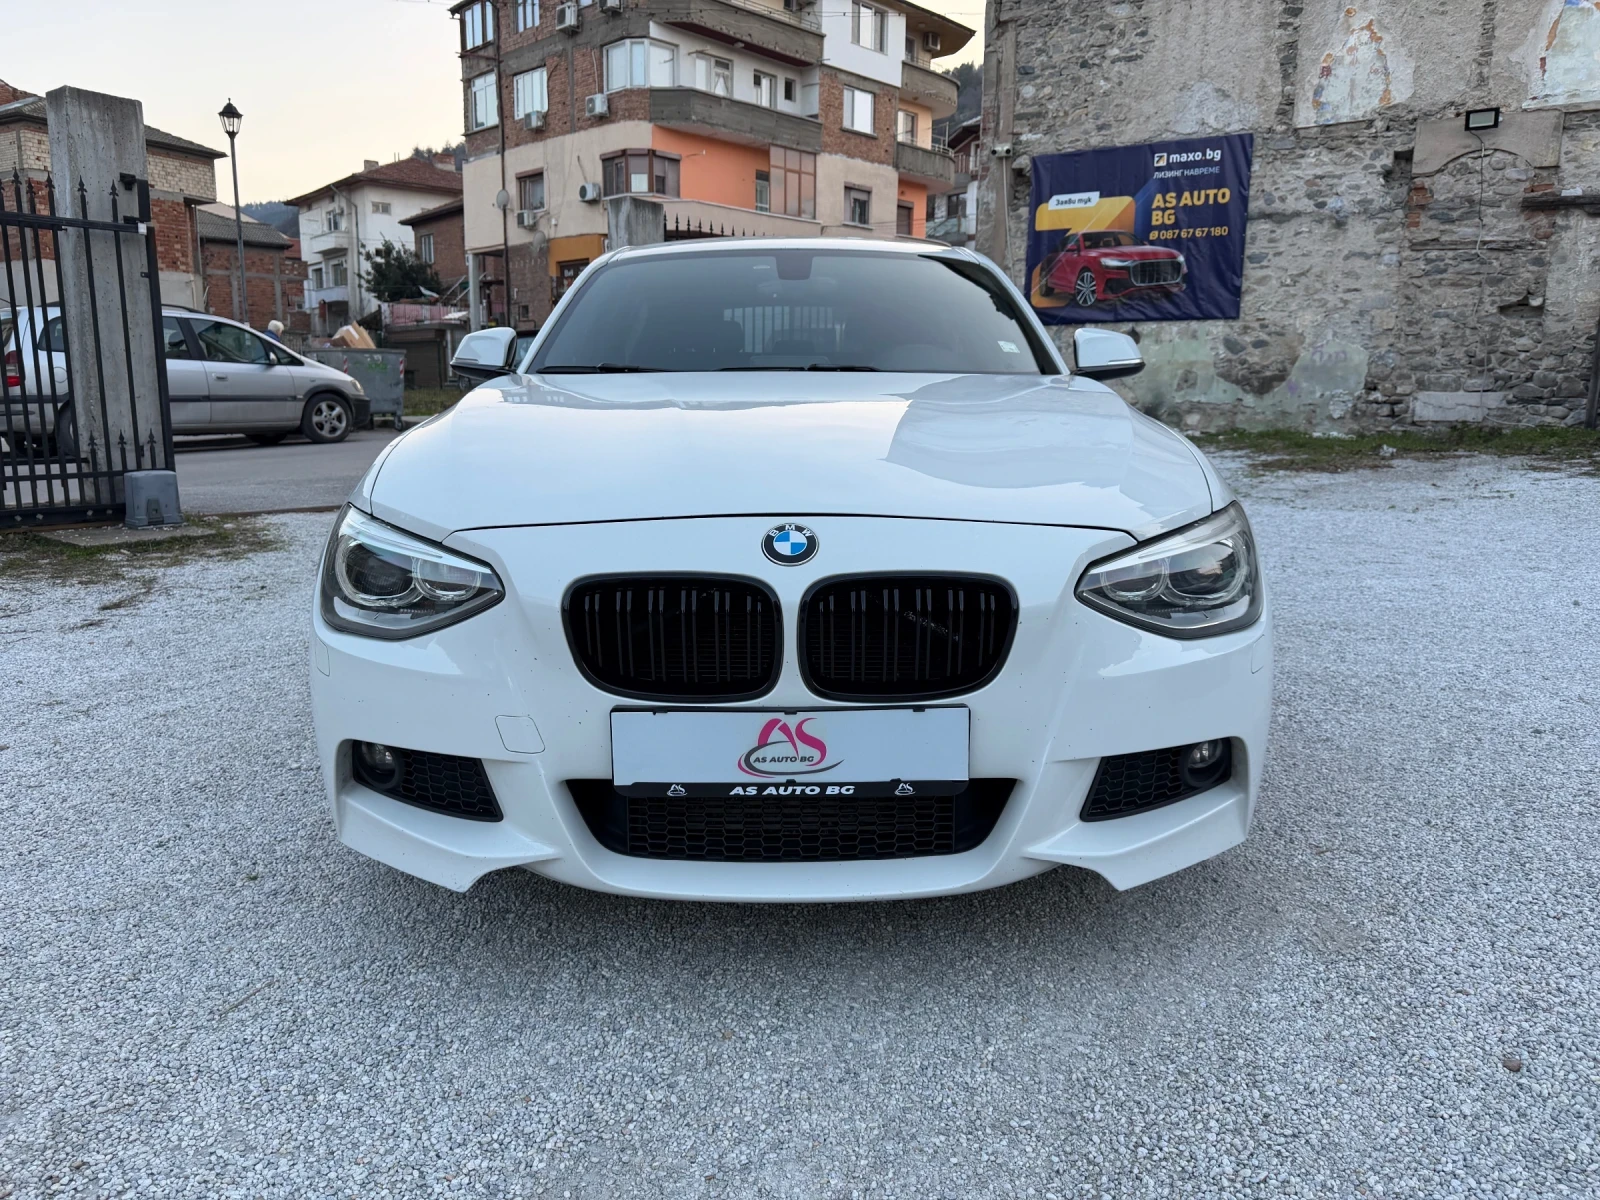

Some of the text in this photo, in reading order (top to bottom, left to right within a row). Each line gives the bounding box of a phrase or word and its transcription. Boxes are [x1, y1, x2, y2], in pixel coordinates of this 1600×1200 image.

[1169, 148, 1222, 163] maxo.bg
[1153, 166, 1220, 179] ЛИЗИНГ НАВРЕМЕ
[1151, 188, 1231, 209] AS AUTO
[1151, 209, 1176, 226] BG
[1160, 226, 1229, 239] 087 67 67 180
[729, 785, 856, 796] AS AUTO BG
